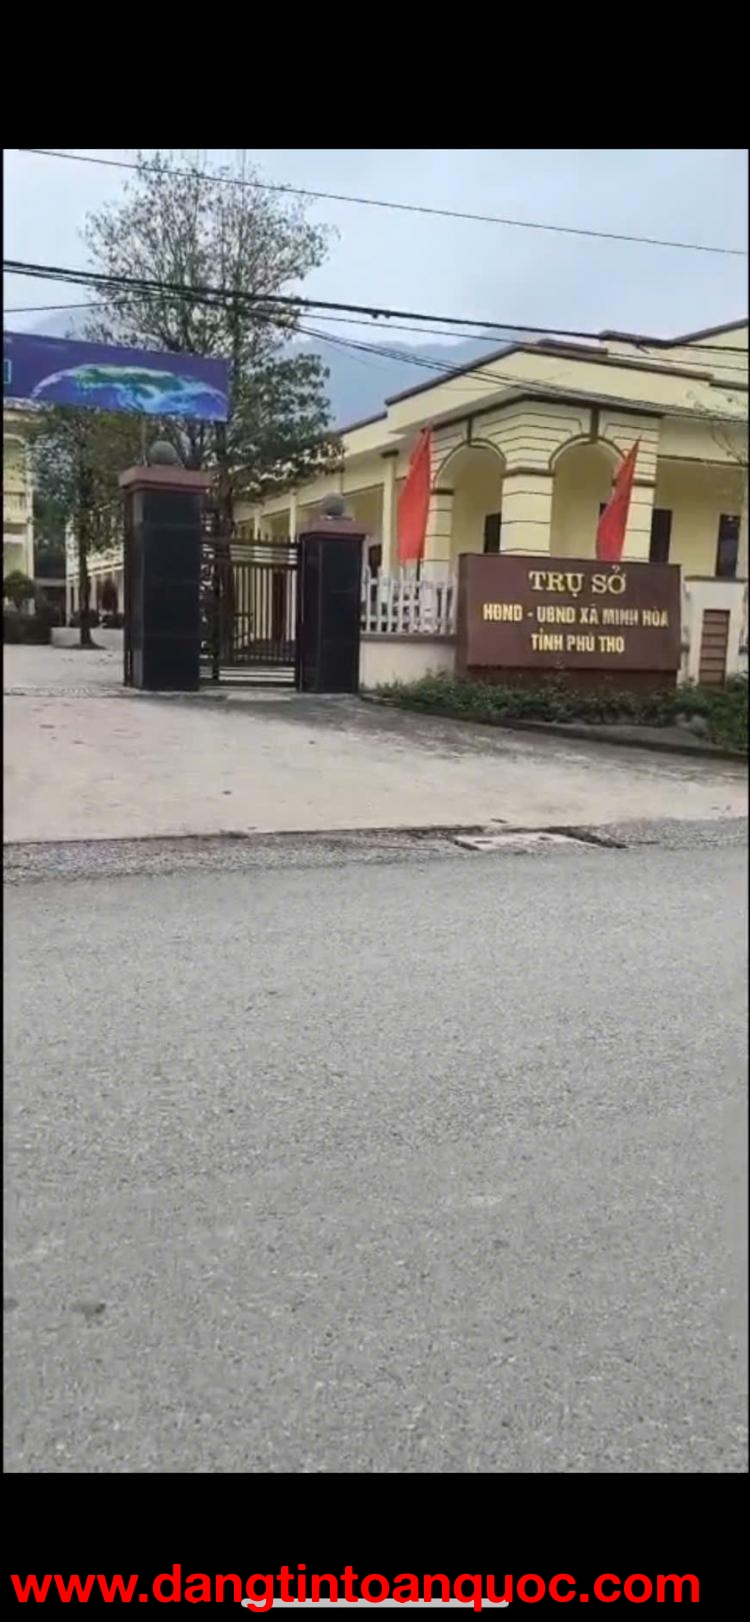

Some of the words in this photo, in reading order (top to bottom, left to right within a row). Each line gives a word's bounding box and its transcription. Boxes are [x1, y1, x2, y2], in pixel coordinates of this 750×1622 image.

[528, 571, 584, 597] TRỤ
[591, 564, 626, 594] SỞ
[537, 606, 576, 624] UBND
[579, 604, 599, 625] XÃ
[602, 608, 639, 626] MINH
[531, 628, 563, 652] TỈNH
